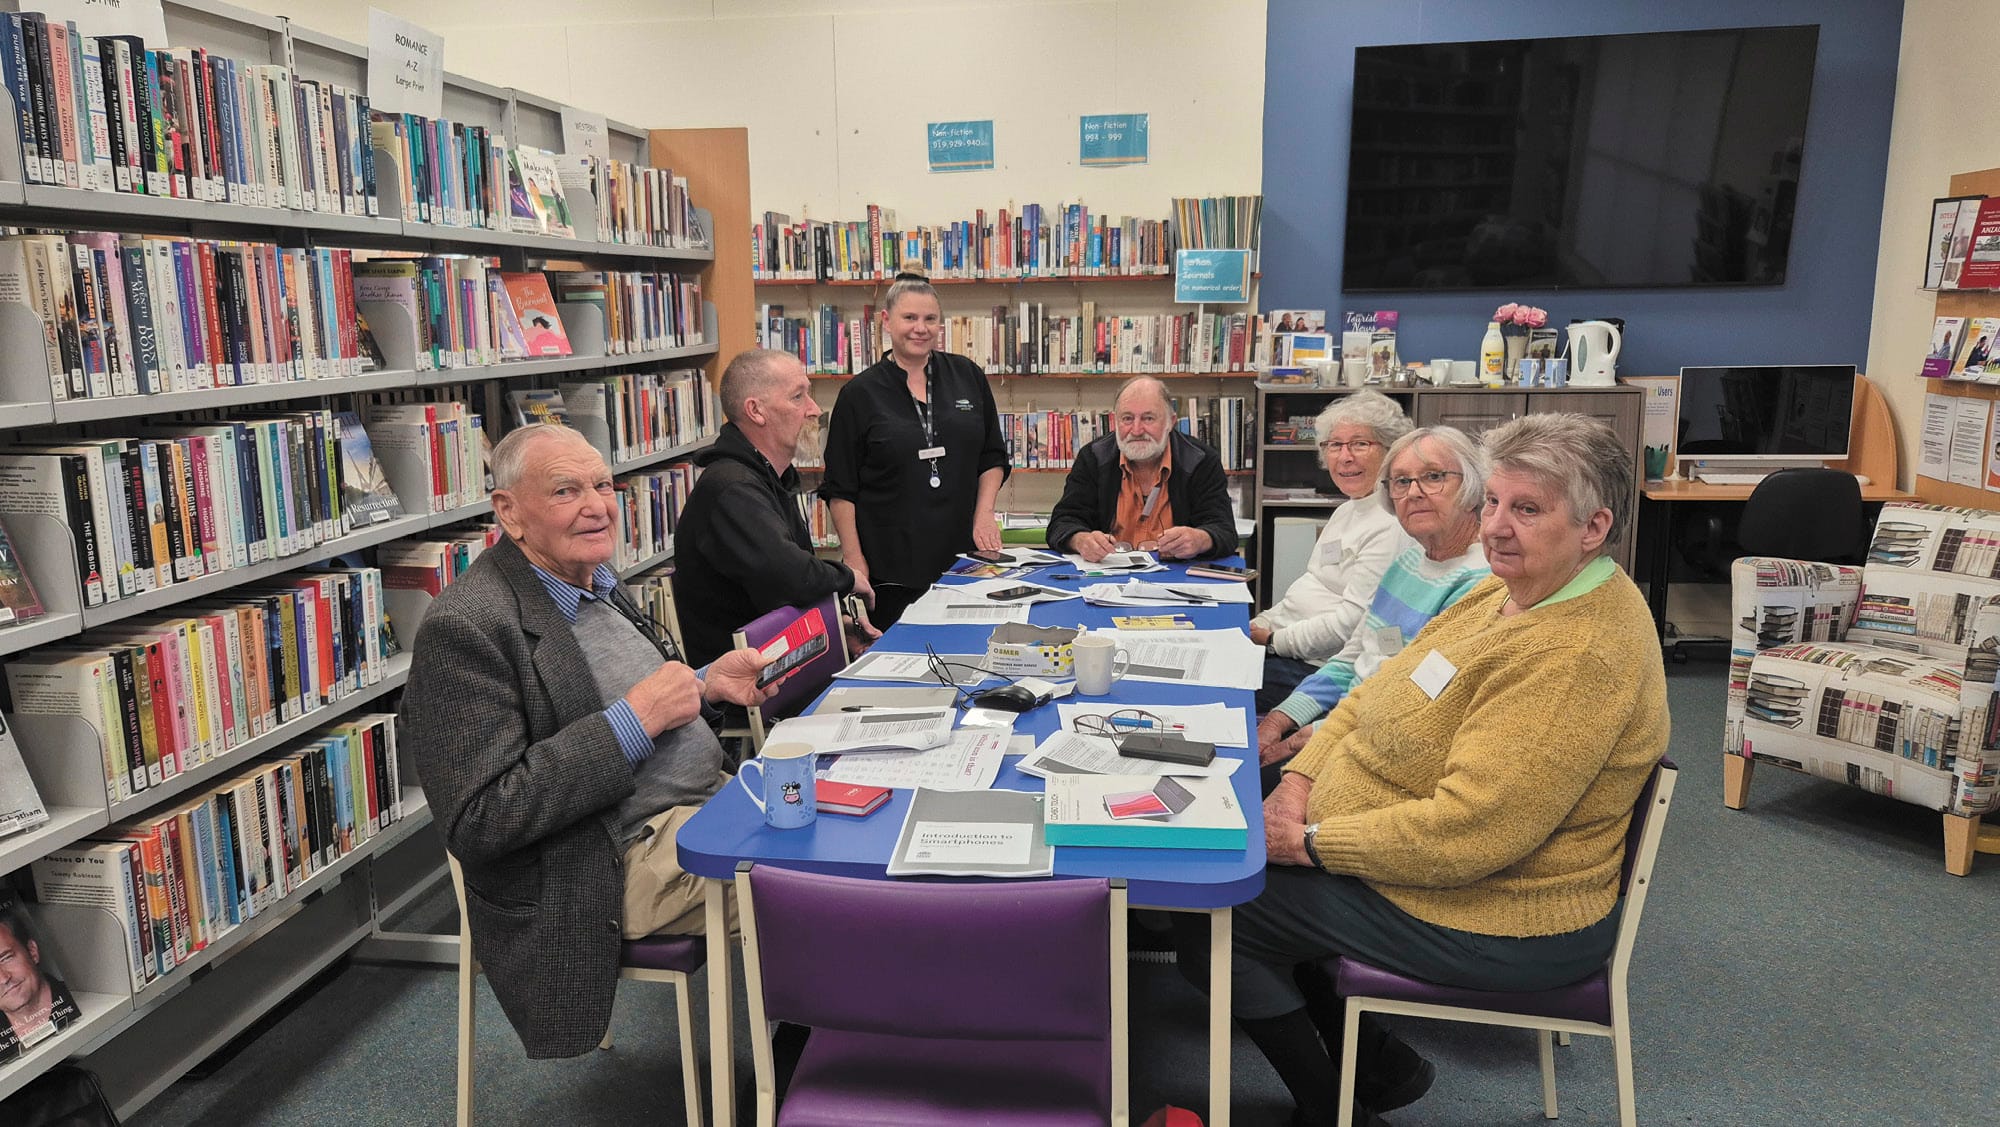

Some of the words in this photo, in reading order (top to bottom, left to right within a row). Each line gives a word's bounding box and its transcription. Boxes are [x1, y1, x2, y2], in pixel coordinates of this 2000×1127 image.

[12, 34, 22, 66] DURING
[56, 47, 64, 68] LITTLE
[395, 33, 428, 56] ROMANCE
[15, 67, 23, 82] THE
[92, 66, 101, 86] mary
[406, 59, 418, 72] A-Z
[58, 70, 66, 103] CHOICES
[86, 65, 96, 104] andrews
[124, 69, 133, 98] Margaret
[395, 74, 412, 90] Large
[412, 80, 425, 92] Print
[34, 84, 45, 113] SOMEONE
[93, 88, 103, 106] kay
[135, 55, 145, 109] MARGARET
[141, 111, 151, 151] ATWOOD
[112, 101, 121, 121] WARM
[127, 100, 135, 123] Atwood
[22, 109, 31, 140] ABRIEL
[38, 115, 48, 140] ALWAYS
[62, 108, 70, 148] ALEXANDER
[92, 115, 102, 155] wreckers
[114, 122, 122, 142] HANDS
[154, 119, 164, 150] SWAMP
[1107, 133, 1122, 141] 999
[1182, 271, 1215, 279] Journals
[1222, 284, 1242, 292] order)
[86, 285, 95, 319] CUSSLER
[130, 281, 140, 305] MAN
[136, 268, 148, 319] ELEVENTH
[523, 287, 535, 297] The
[42, 298, 51, 319] Touch
[104, 289, 114, 323] CUSSLER
[1345, 311, 1378, 324] Tourist
[1352, 322, 1376, 332] News
[138, 325, 151, 364] DOIG
[146, 327, 157, 363] IVAN
[1657, 386, 1673, 396] Users
[530, 403, 549, 416] ONE
[132, 466, 141, 479] THE
[182, 456, 192, 479] JACK
[197, 462, 206, 498] SUNSHINE
[81, 474, 89, 500] HEATHER
[134, 480, 144, 510] DESCENT
[185, 481, 197, 517] HIGGINS
[350, 496, 400, 513] Resurrection
[83, 521, 92, 537] THE
[202, 507, 211, 539] HIGGINS
[208, 506, 216, 538] KRISTAN
[86, 539, 97, 573] FORBID
[243, 623, 252, 655] SISTERS
[993, 647, 1020, 656] OSMER
[193, 662, 203, 701] HEARTBREAK
[129, 713, 137, 734] GRANT
[256, 777, 267, 817] DANIELLE
[259, 818, 269, 842] STEEL
[920, 838, 1004, 846] Smartphones
[124, 872, 132, 894] Photos
[136, 874, 145, 902] LAST
[177, 880, 186, 911] LYNDON
[140, 904, 149, 931] DAYS
[168, 873, 178, 909] KITCHEN
[174, 912, 183, 940] FRONT
[0, 1020, 25, 1038] riends,
[51, 995, 64, 1009] and
[0, 1041, 10, 1052] he
[51, 1005, 74, 1020] Thing
